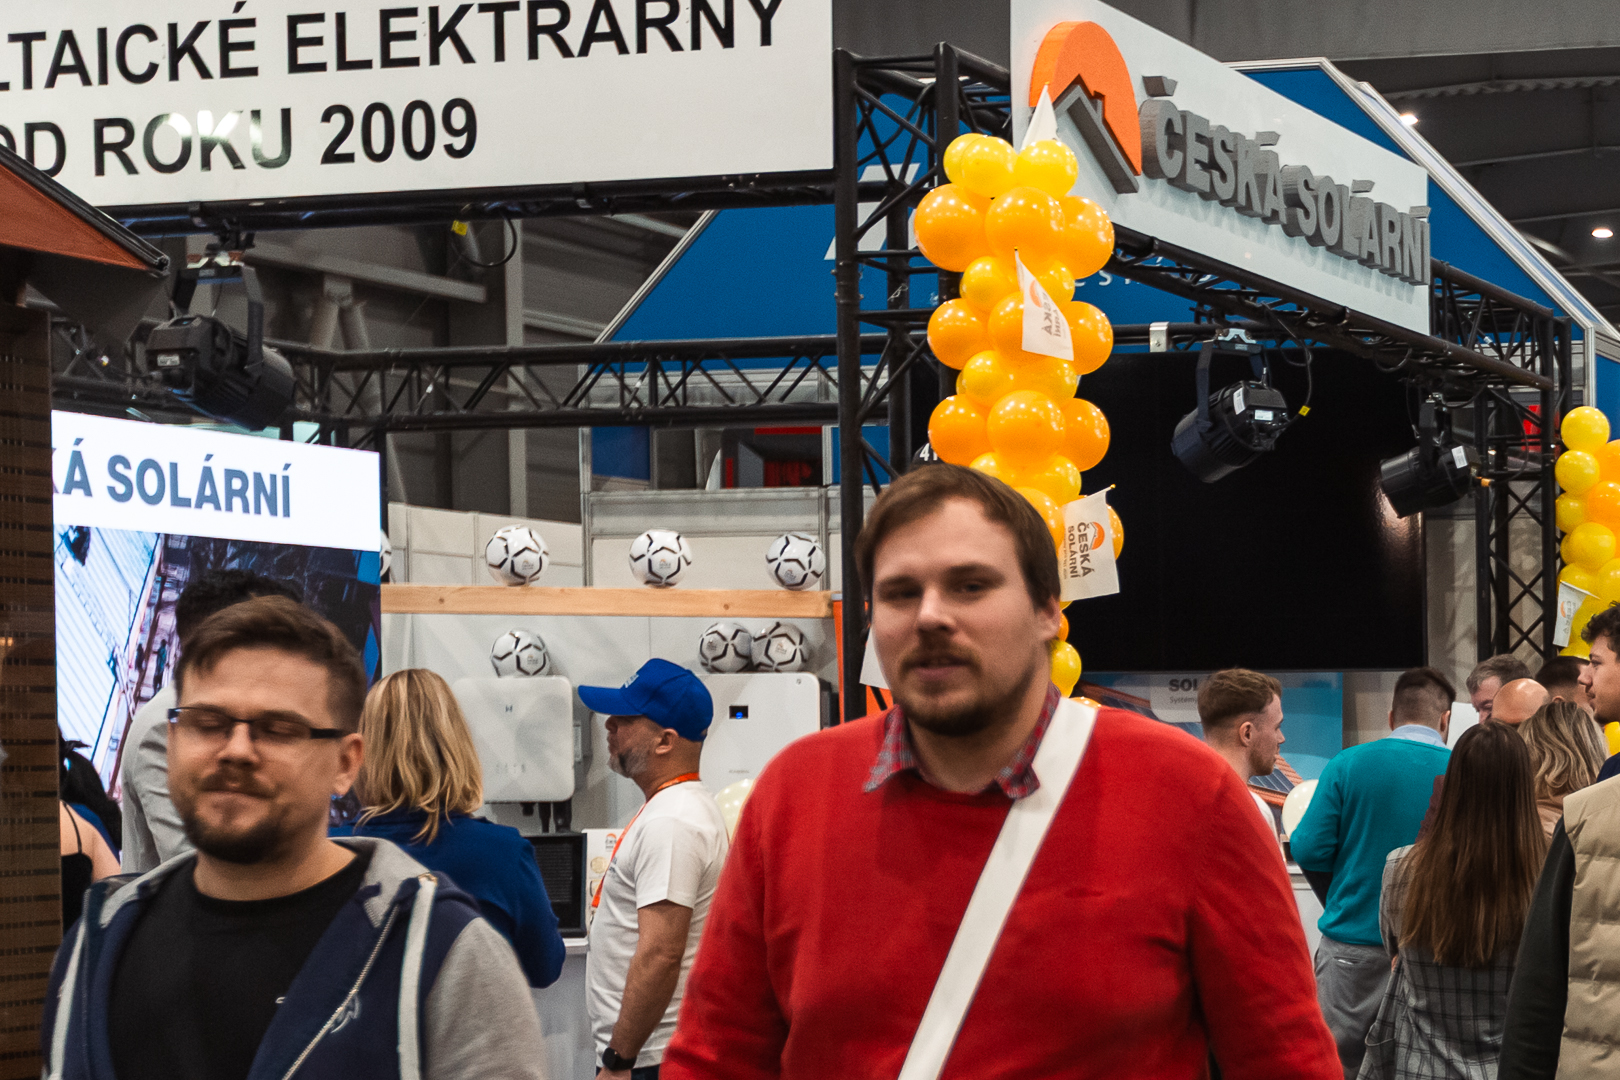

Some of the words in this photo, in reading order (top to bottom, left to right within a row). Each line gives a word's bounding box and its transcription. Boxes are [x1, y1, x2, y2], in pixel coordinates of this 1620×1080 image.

[94, 107, 292, 177] ROKU
[320, 97, 477, 165] 2009
[1139, 75, 1287, 225] ČESKÁ
[1281, 164, 1431, 286] SOLÁRNÍ
[106, 453, 291, 518] SOLÁRNÍ
[1068, 526, 1081, 578] SOLÁRNÍ
[1077, 522, 1095, 577] ČESKÁ
